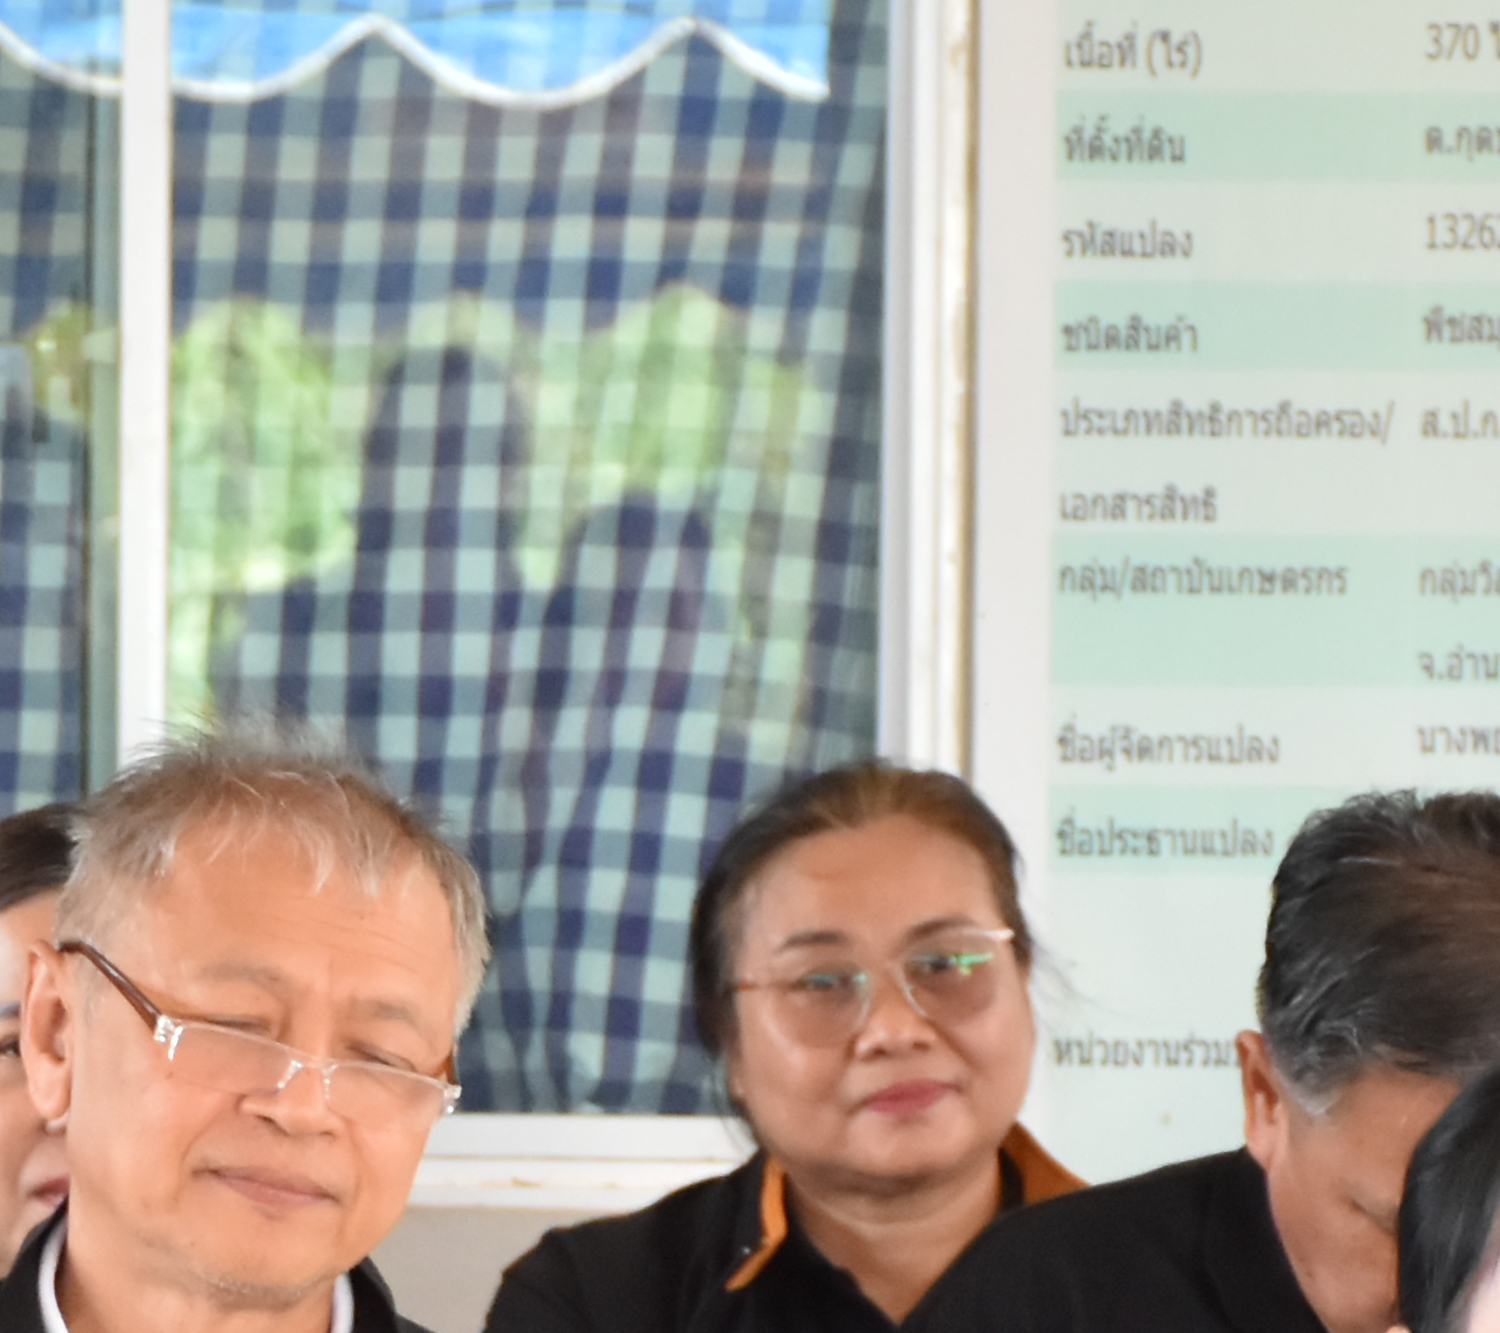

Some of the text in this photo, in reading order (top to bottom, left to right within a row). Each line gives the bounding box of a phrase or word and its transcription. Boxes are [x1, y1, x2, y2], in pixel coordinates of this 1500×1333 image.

[1064, 21, 1137, 70] เนื้อที่
[1427, 22, 1480, 61] 370
[1061, 220, 1193, 260] รหัสแปลง
